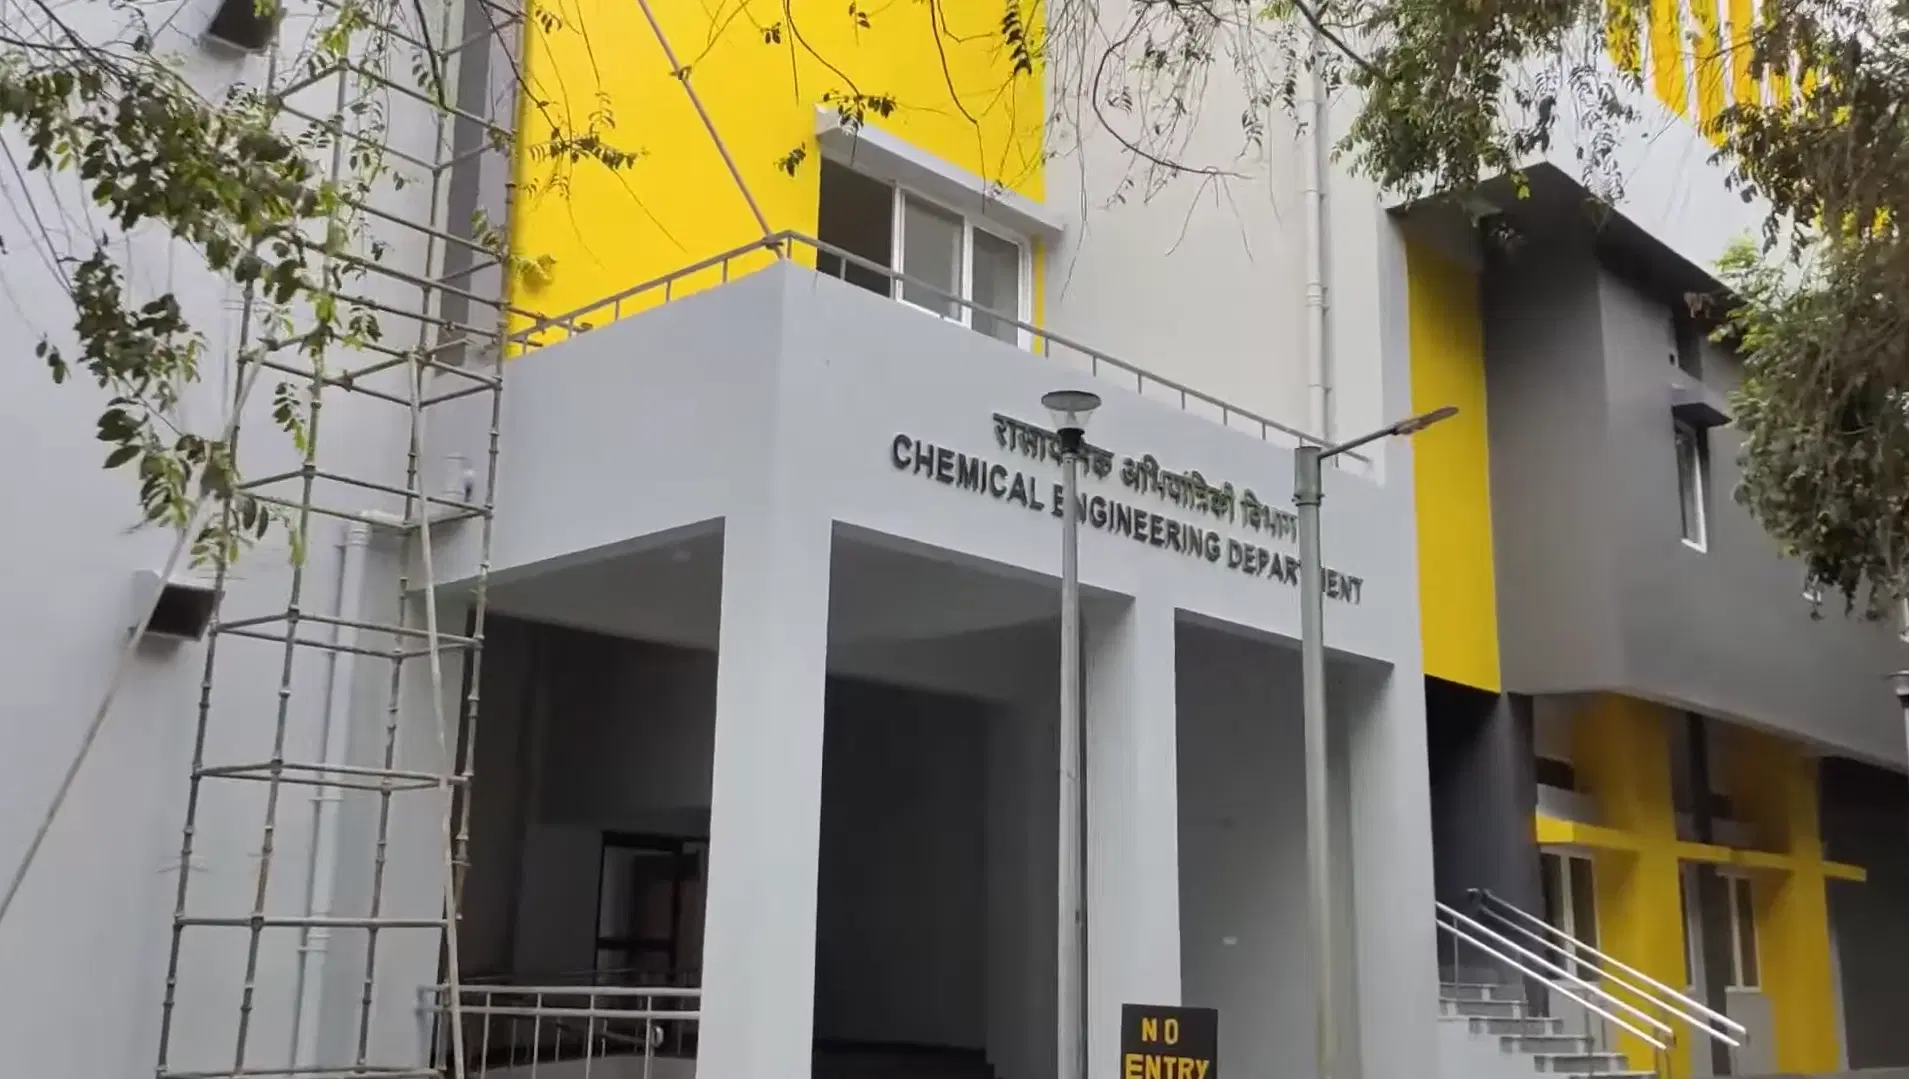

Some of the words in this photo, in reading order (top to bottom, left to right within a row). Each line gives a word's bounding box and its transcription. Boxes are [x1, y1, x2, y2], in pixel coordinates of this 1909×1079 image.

[1120, 453, 1236, 524] अभियांत्रिकी
[892, 433, 1045, 511] CHEMICAL
[1227, 537, 1364, 605] DEPARENT
[1141, 1017, 1179, 1045] NO
[1125, 1053, 1210, 1079] ENTRY
